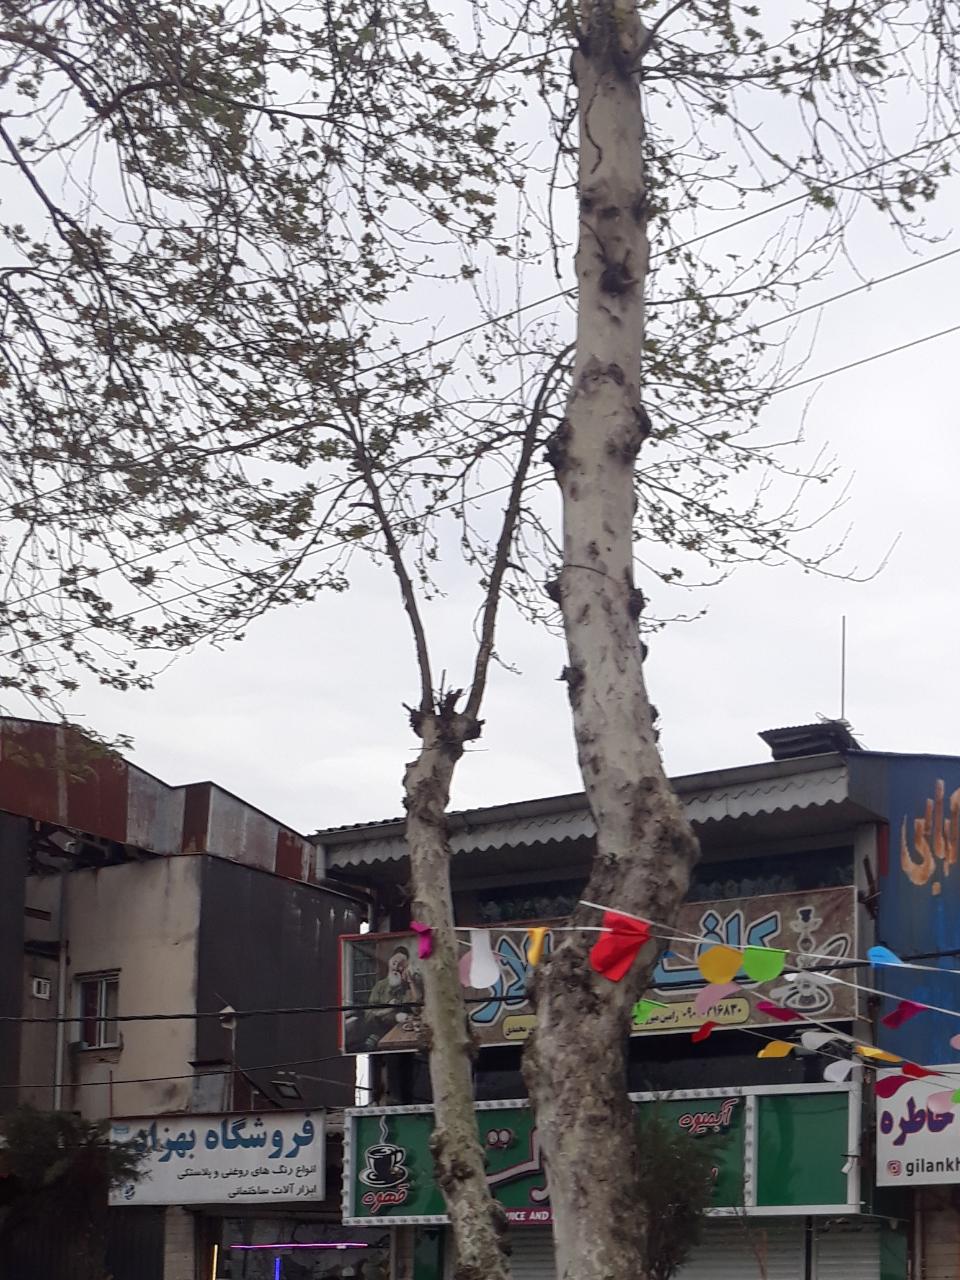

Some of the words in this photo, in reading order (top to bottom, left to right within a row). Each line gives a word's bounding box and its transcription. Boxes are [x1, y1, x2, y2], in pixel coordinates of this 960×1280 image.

[679, 1098, 739, 1135] آبمیوه
[205, 1111, 315, 1159] فروشگاه
[221, 1167, 250, 1179] روغنی
[250, 1166, 270, 1177] های
[272, 1164, 294, 1177] رنگ
[295, 1164, 317, 1178] انواع
[227, 1185, 270, 1199] ساختمانی
[271, 1182, 295, 1195] آلات
[296, 1184, 317, 1197] ابزار
[362, 1183, 410, 1214] قهوه
[505, 1211, 526, 1221] ICE
[529, 1210, 549, 1221] AND
